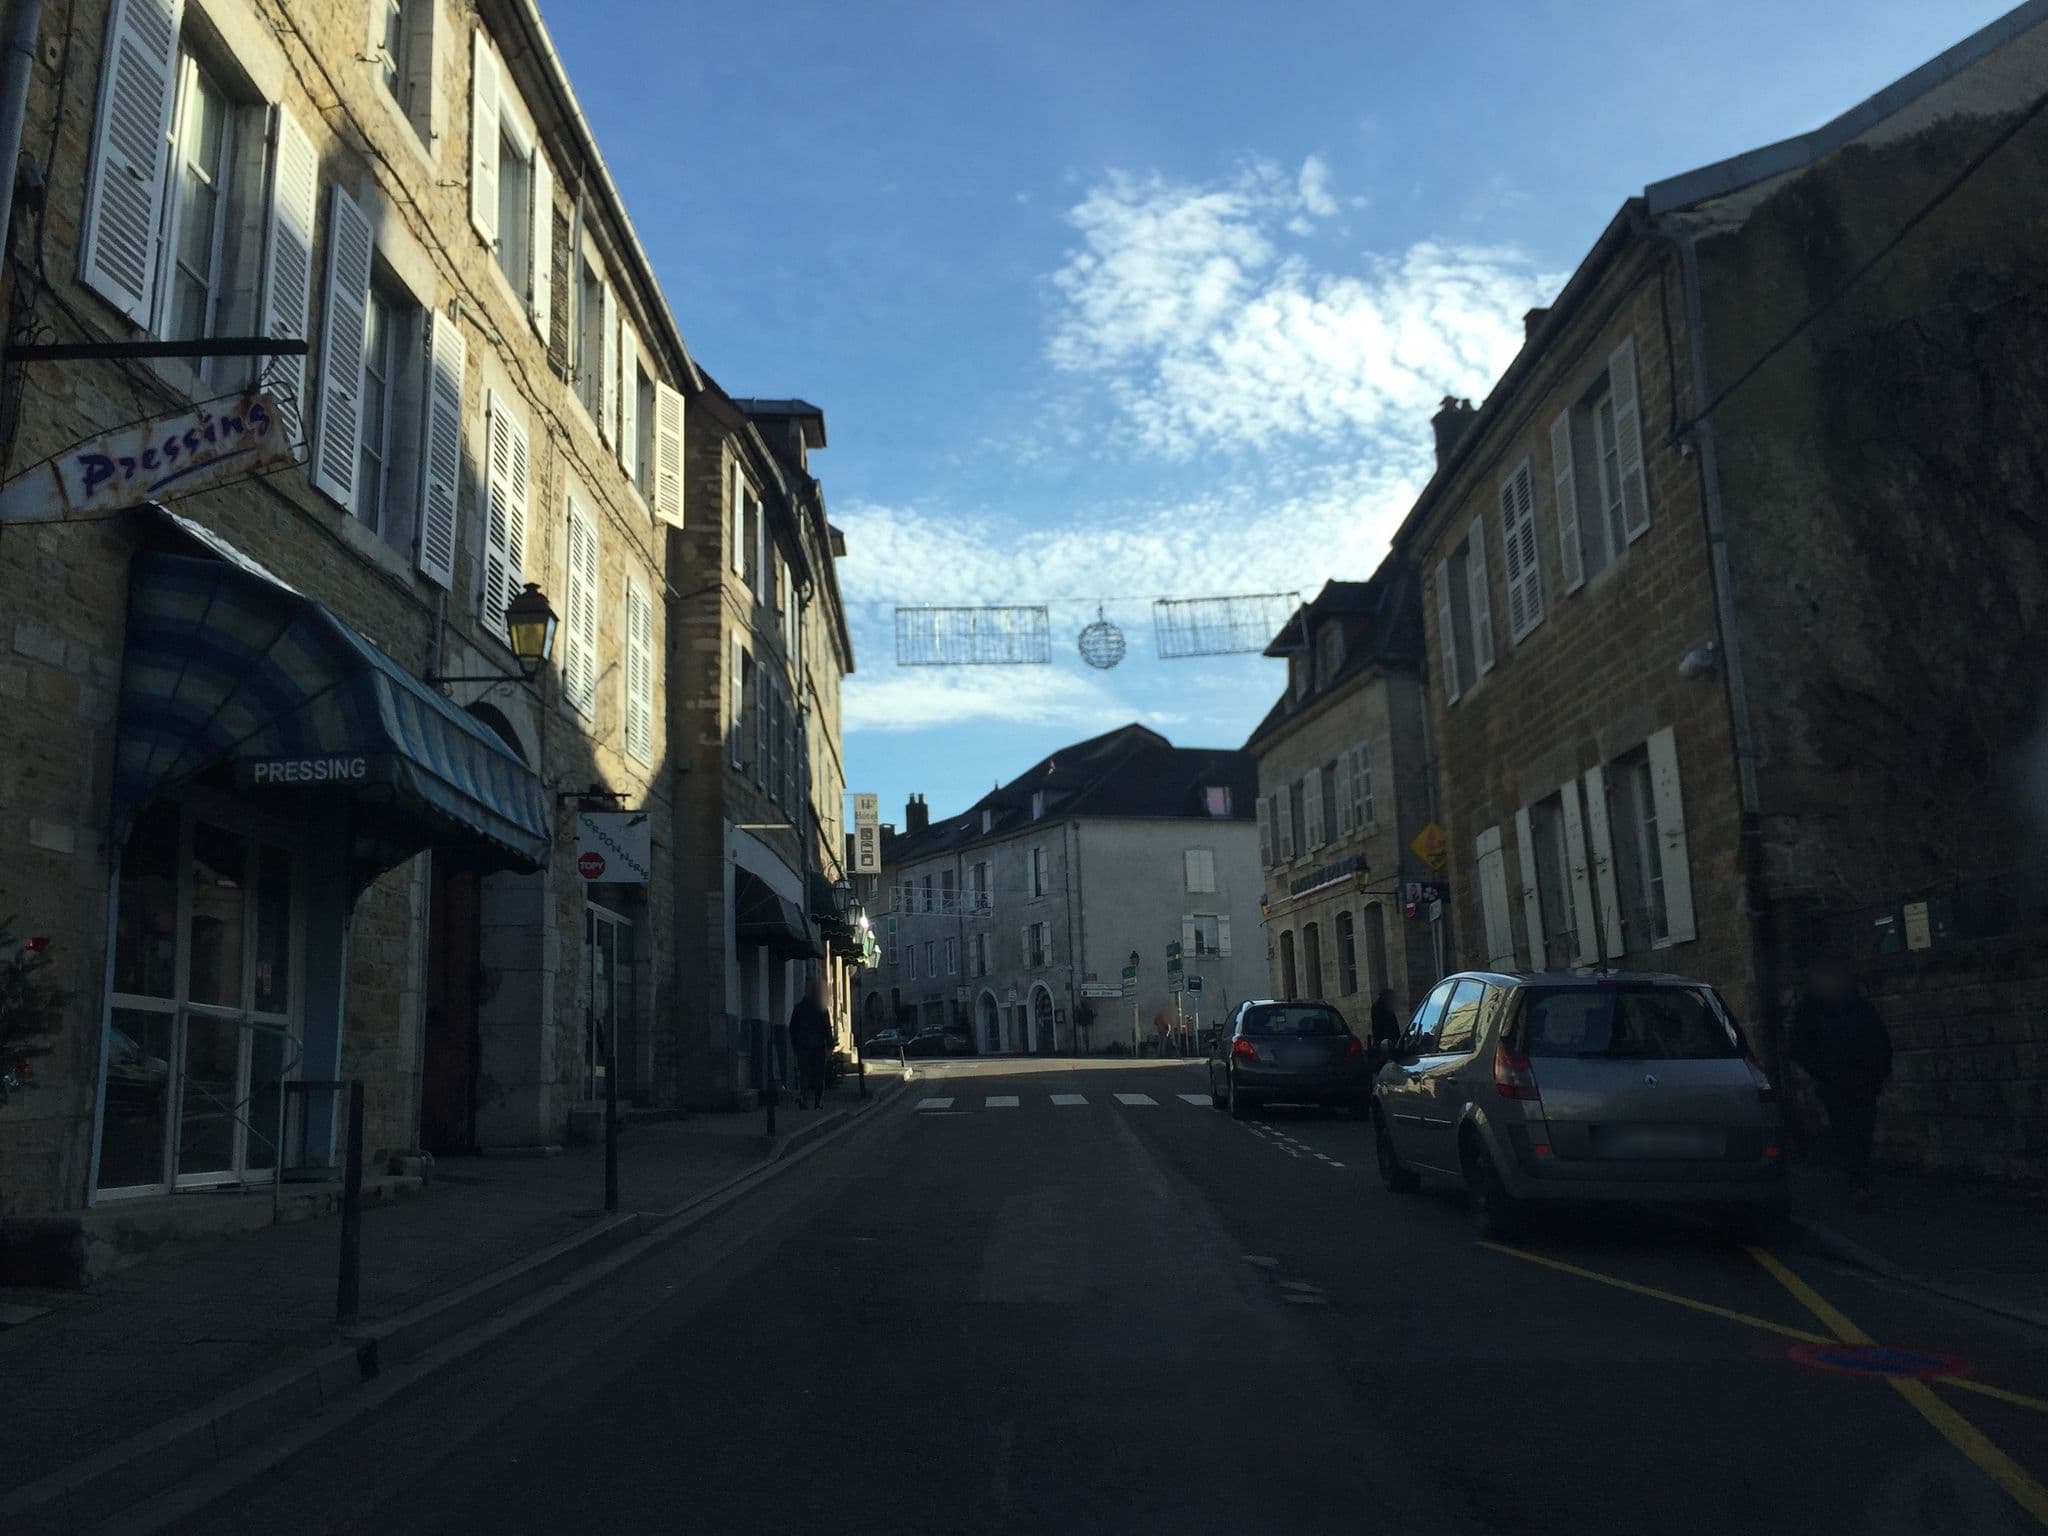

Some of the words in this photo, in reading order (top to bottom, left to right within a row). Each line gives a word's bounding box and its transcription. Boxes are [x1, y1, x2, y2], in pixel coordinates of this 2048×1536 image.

[77, 403, 272, 498] Pressing
[254, 757, 366, 783] PRESSING
[580, 862, 604, 870] TOPY
